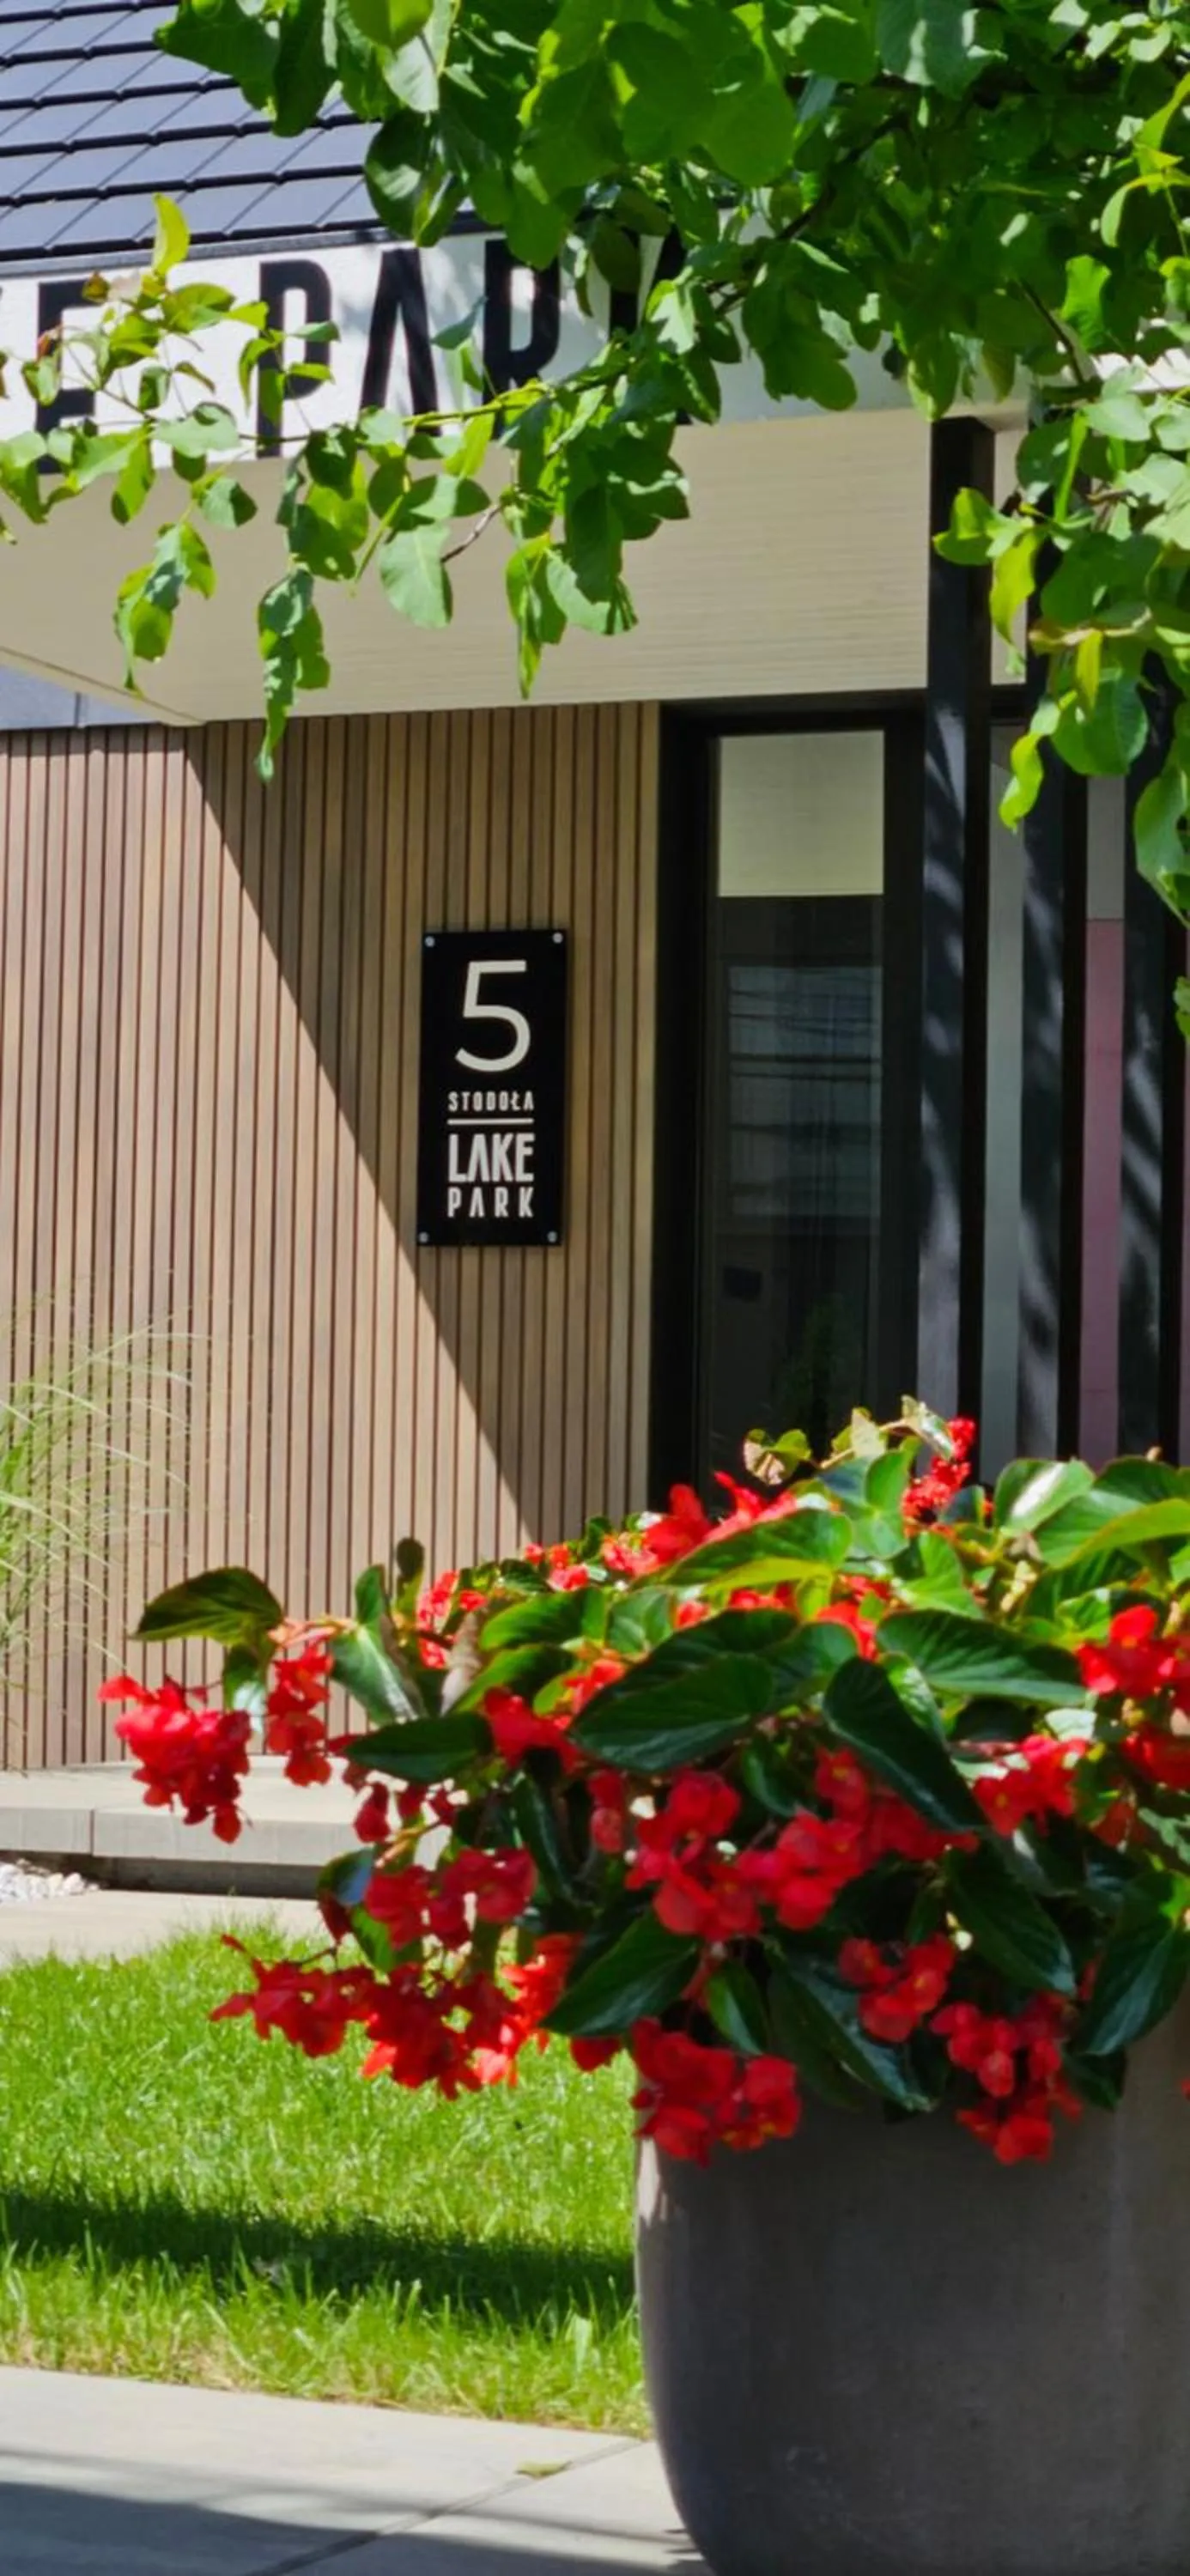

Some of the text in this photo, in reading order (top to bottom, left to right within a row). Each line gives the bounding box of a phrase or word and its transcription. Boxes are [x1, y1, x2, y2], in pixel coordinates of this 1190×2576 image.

[455, 959, 531, 1072] 5
[447, 1091, 534, 1111] STODOŁA
[448, 1133, 535, 1182] LAKE
[447, 1186, 533, 1218] PARK
